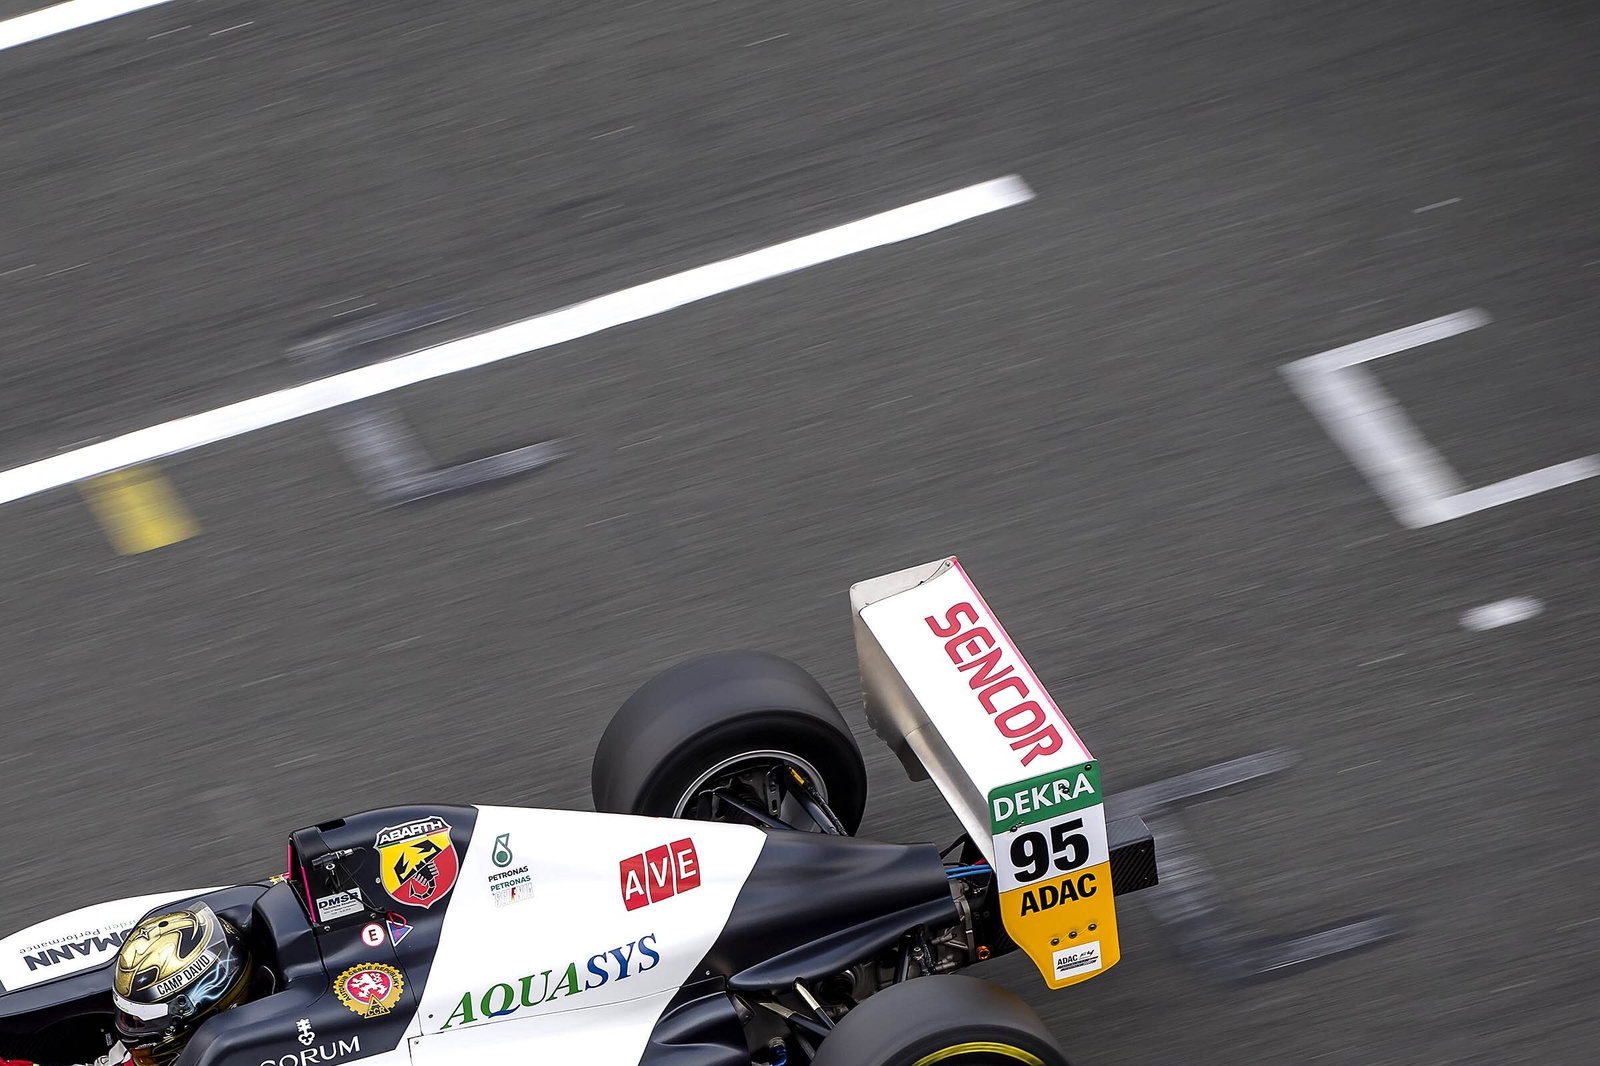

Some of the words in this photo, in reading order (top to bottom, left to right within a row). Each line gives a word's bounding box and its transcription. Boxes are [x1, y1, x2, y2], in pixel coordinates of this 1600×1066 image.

[924, 601, 1065, 767] SENCOR
[993, 773, 1096, 822] DEKRA
[379, 820, 444, 845] ABARTH
[1010, 817, 1090, 883] 95
[488, 865, 529, 882] PETRONAS
[490, 874, 532, 892] PETRONAS
[624, 847, 698, 902] AVE
[1021, 873, 1098, 917] ADAC
[318, 891, 359, 909] DMSB
[156, 975, 183, 996] CAMP
[183, 954, 210, 981] DAVID
[439, 933, 661, 1031] AQUASYS
